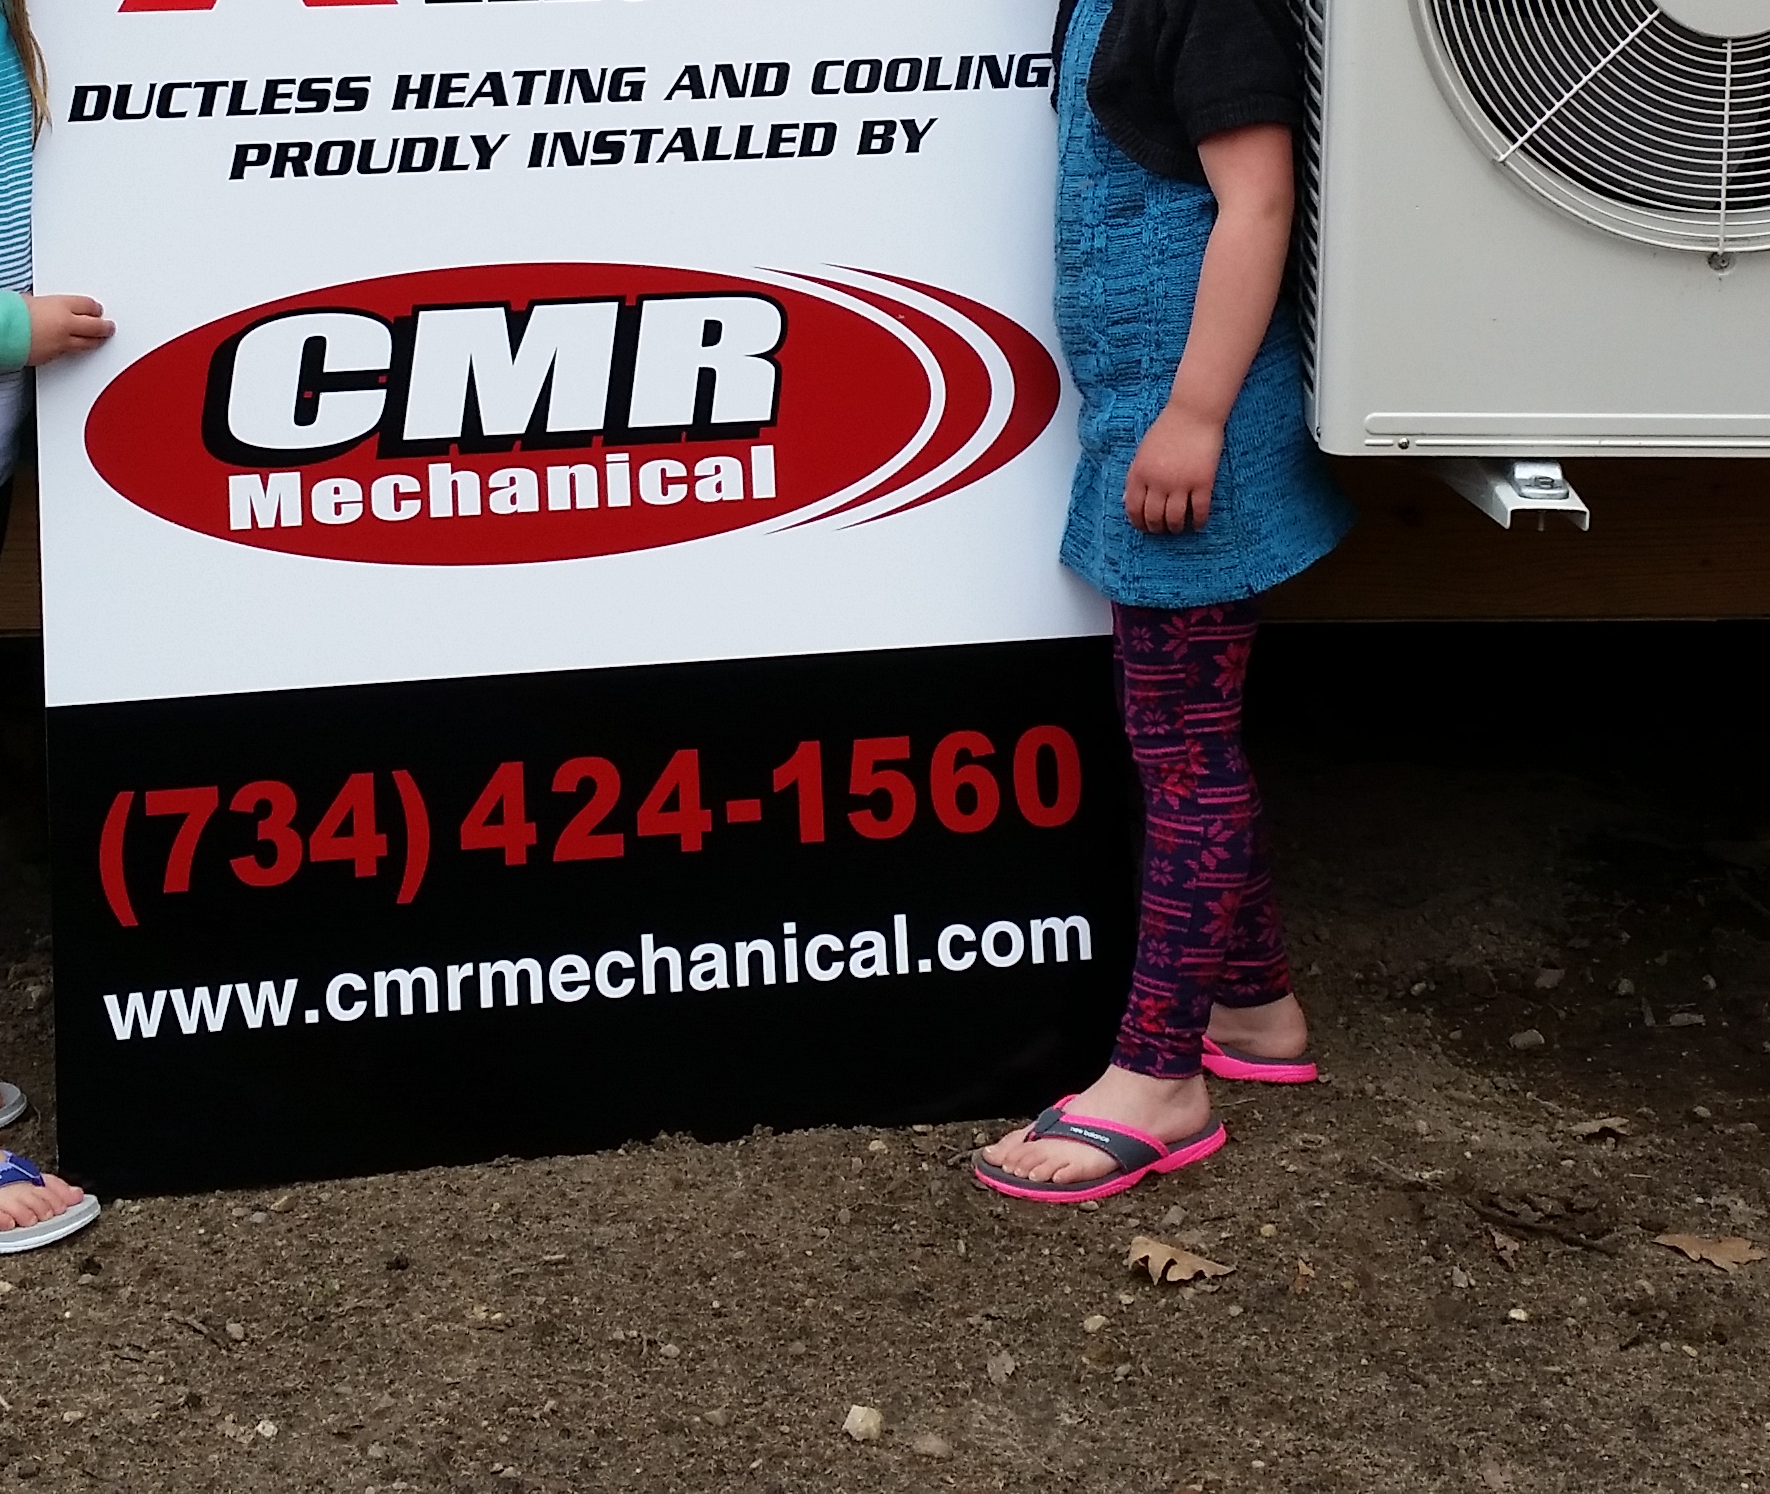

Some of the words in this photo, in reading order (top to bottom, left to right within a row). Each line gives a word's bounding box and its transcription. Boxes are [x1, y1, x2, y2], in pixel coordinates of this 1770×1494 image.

[67, 74, 372, 123] DUCTLESS
[391, 64, 646, 112] HEATING
[663, 61, 791, 102] AND
[811, 52, 1053, 96] COOLING
[228, 131, 511, 181] PROUDLY
[527, 121, 838, 169] INSTALLED
[856, 117, 939, 156] BY
[214, 293, 785, 458] CMR
[228, 444, 776, 531] Mechanical
[99, 770, 430, 927] (734)
[460, 724, 1080, 867] 424-1560
[103, 913, 1092, 1041] www.cmrmechanical.com
[1083, 1129, 1110, 1143] balance
